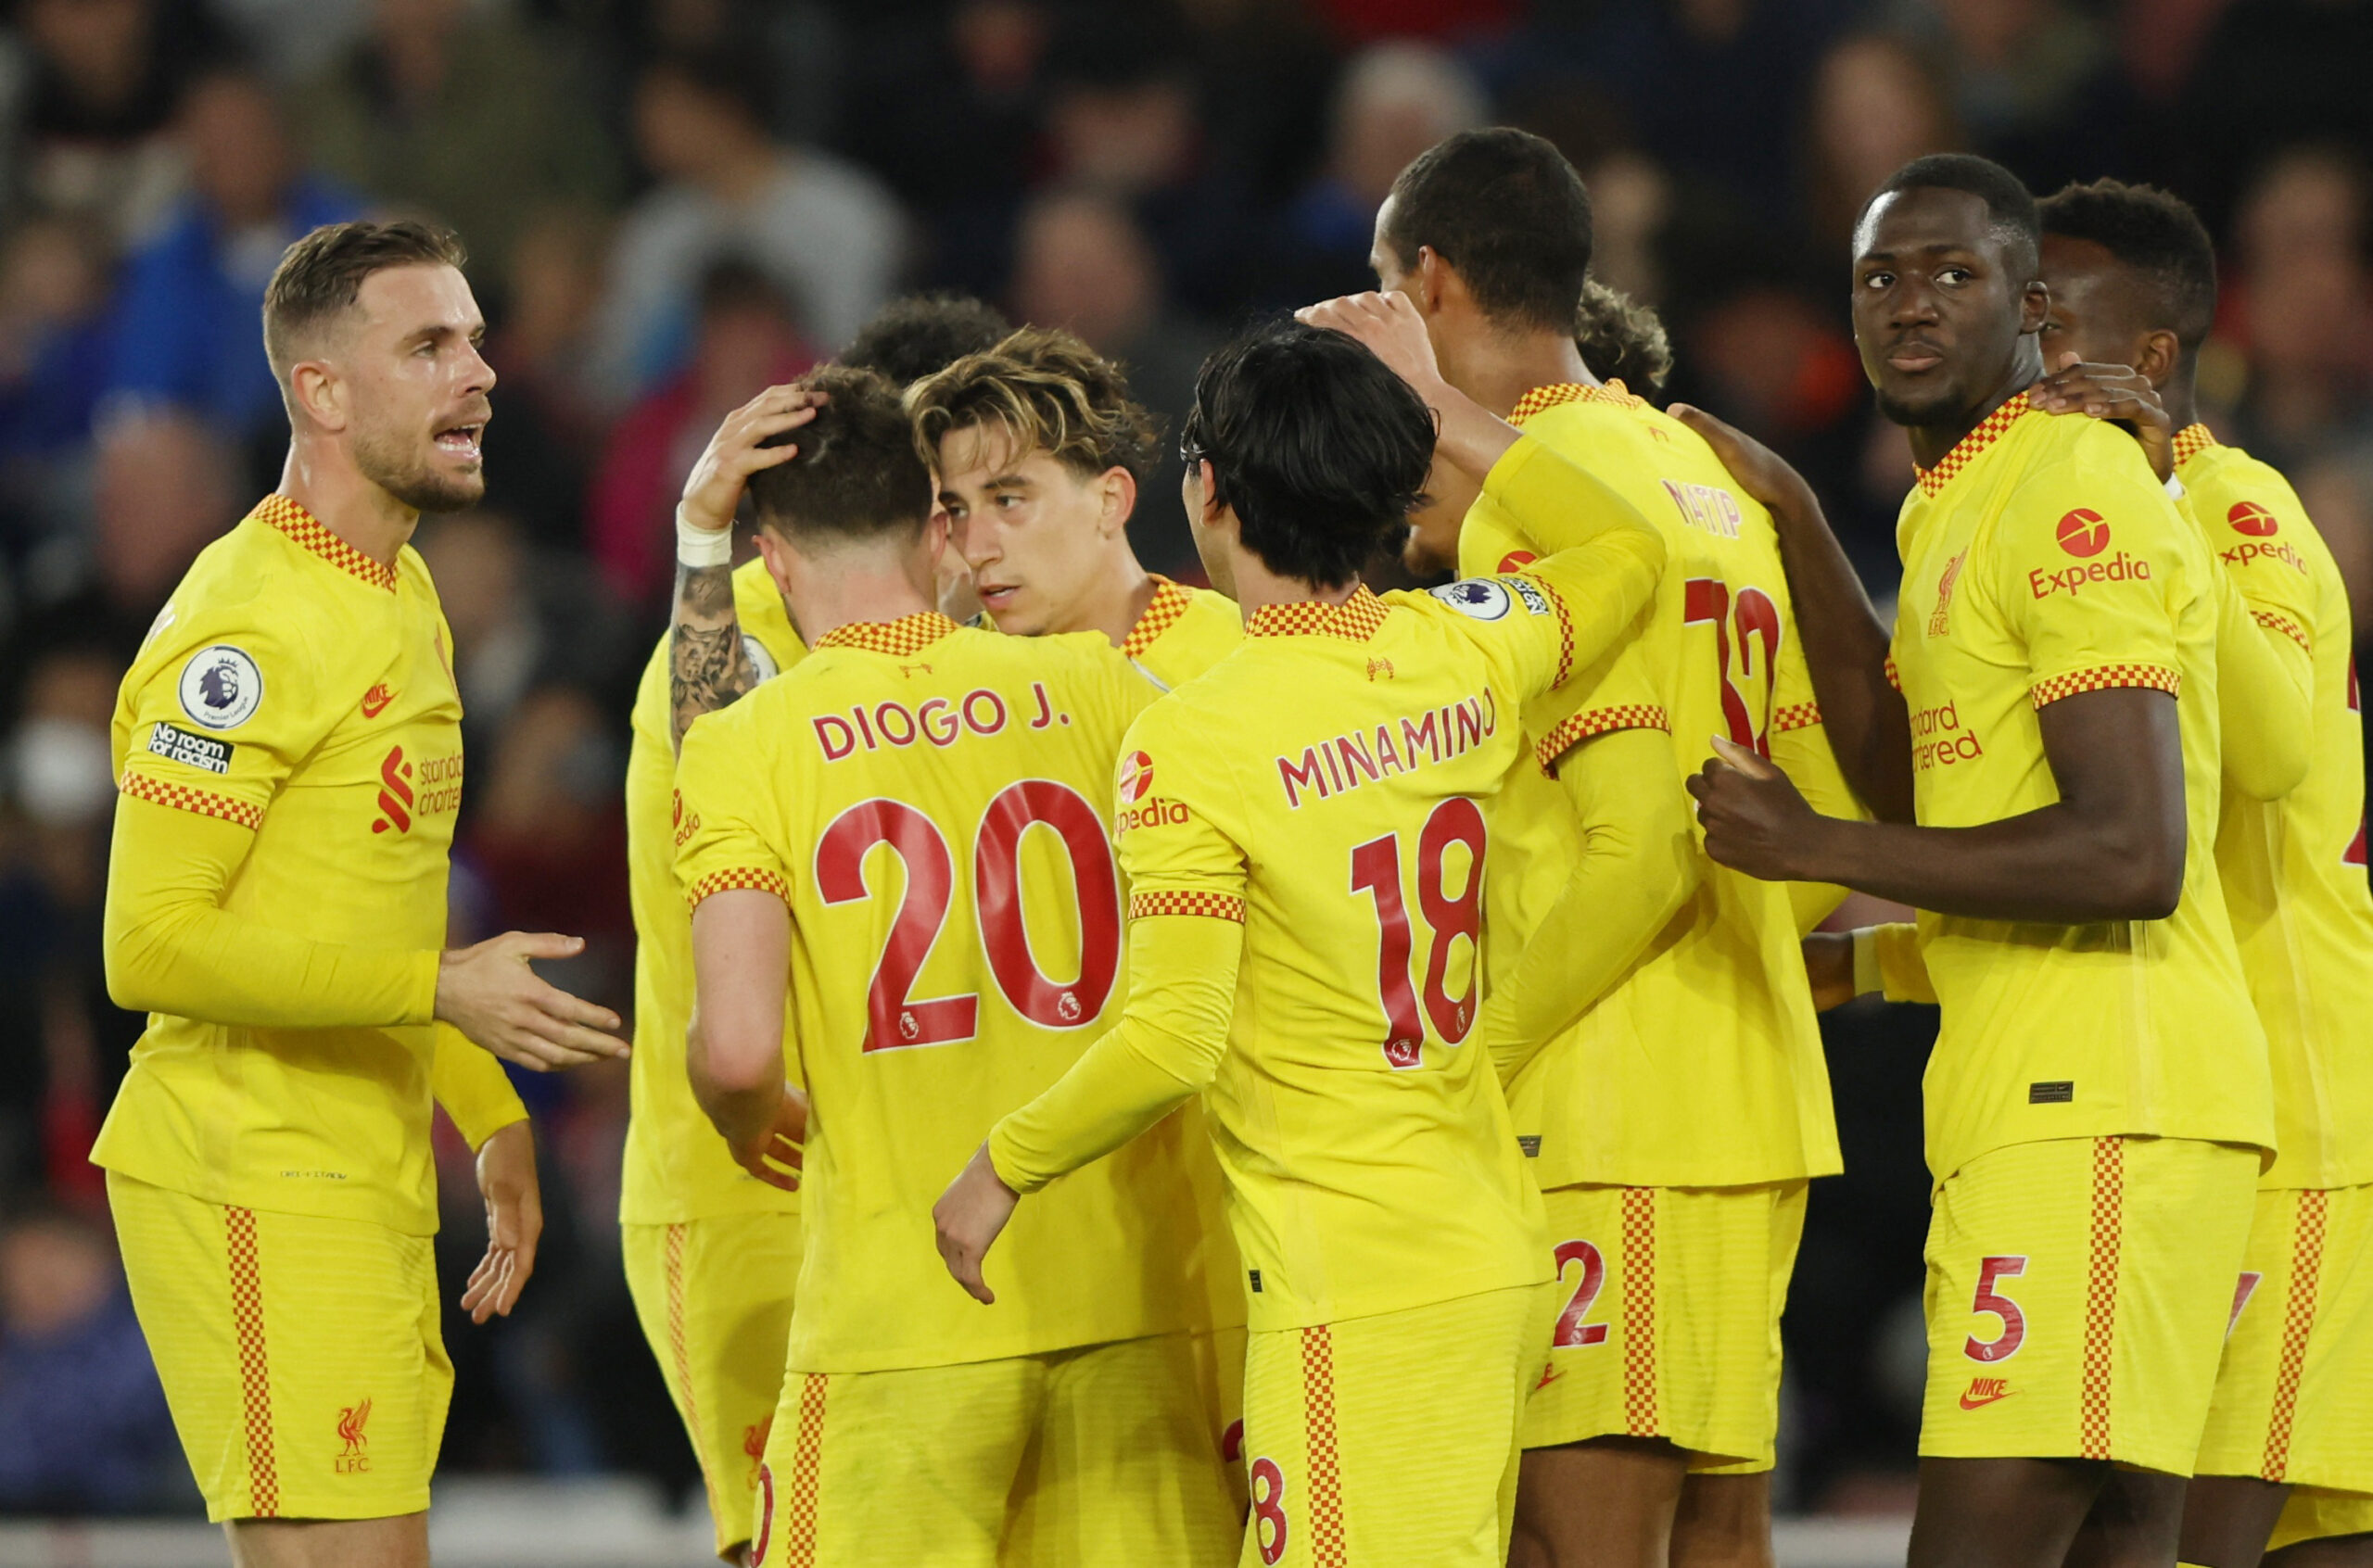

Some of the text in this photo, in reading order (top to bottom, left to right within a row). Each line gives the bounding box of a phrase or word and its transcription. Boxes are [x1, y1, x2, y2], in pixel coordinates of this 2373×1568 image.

[1660, 478, 1742, 539] MATIP
[2028, 551, 2151, 600] Expedia
[362, 683, 388, 705] NIKE
[811, 682, 1072, 763] DIOGO J.
[153, 722, 224, 759] No room
[171, 745, 228, 775] racism
[1275, 686, 1497, 810] MINAMINO
[1115, 797, 1189, 842] pedia
[813, 778, 1124, 1055] 20
[1348, 796, 1487, 1070] 18
[1552, 1238, 1610, 1349] 2
[1963, 1255, 2028, 1362] 5
[1968, 1377, 2009, 1396] NIKE
[1250, 1456, 1288, 1566] 8
